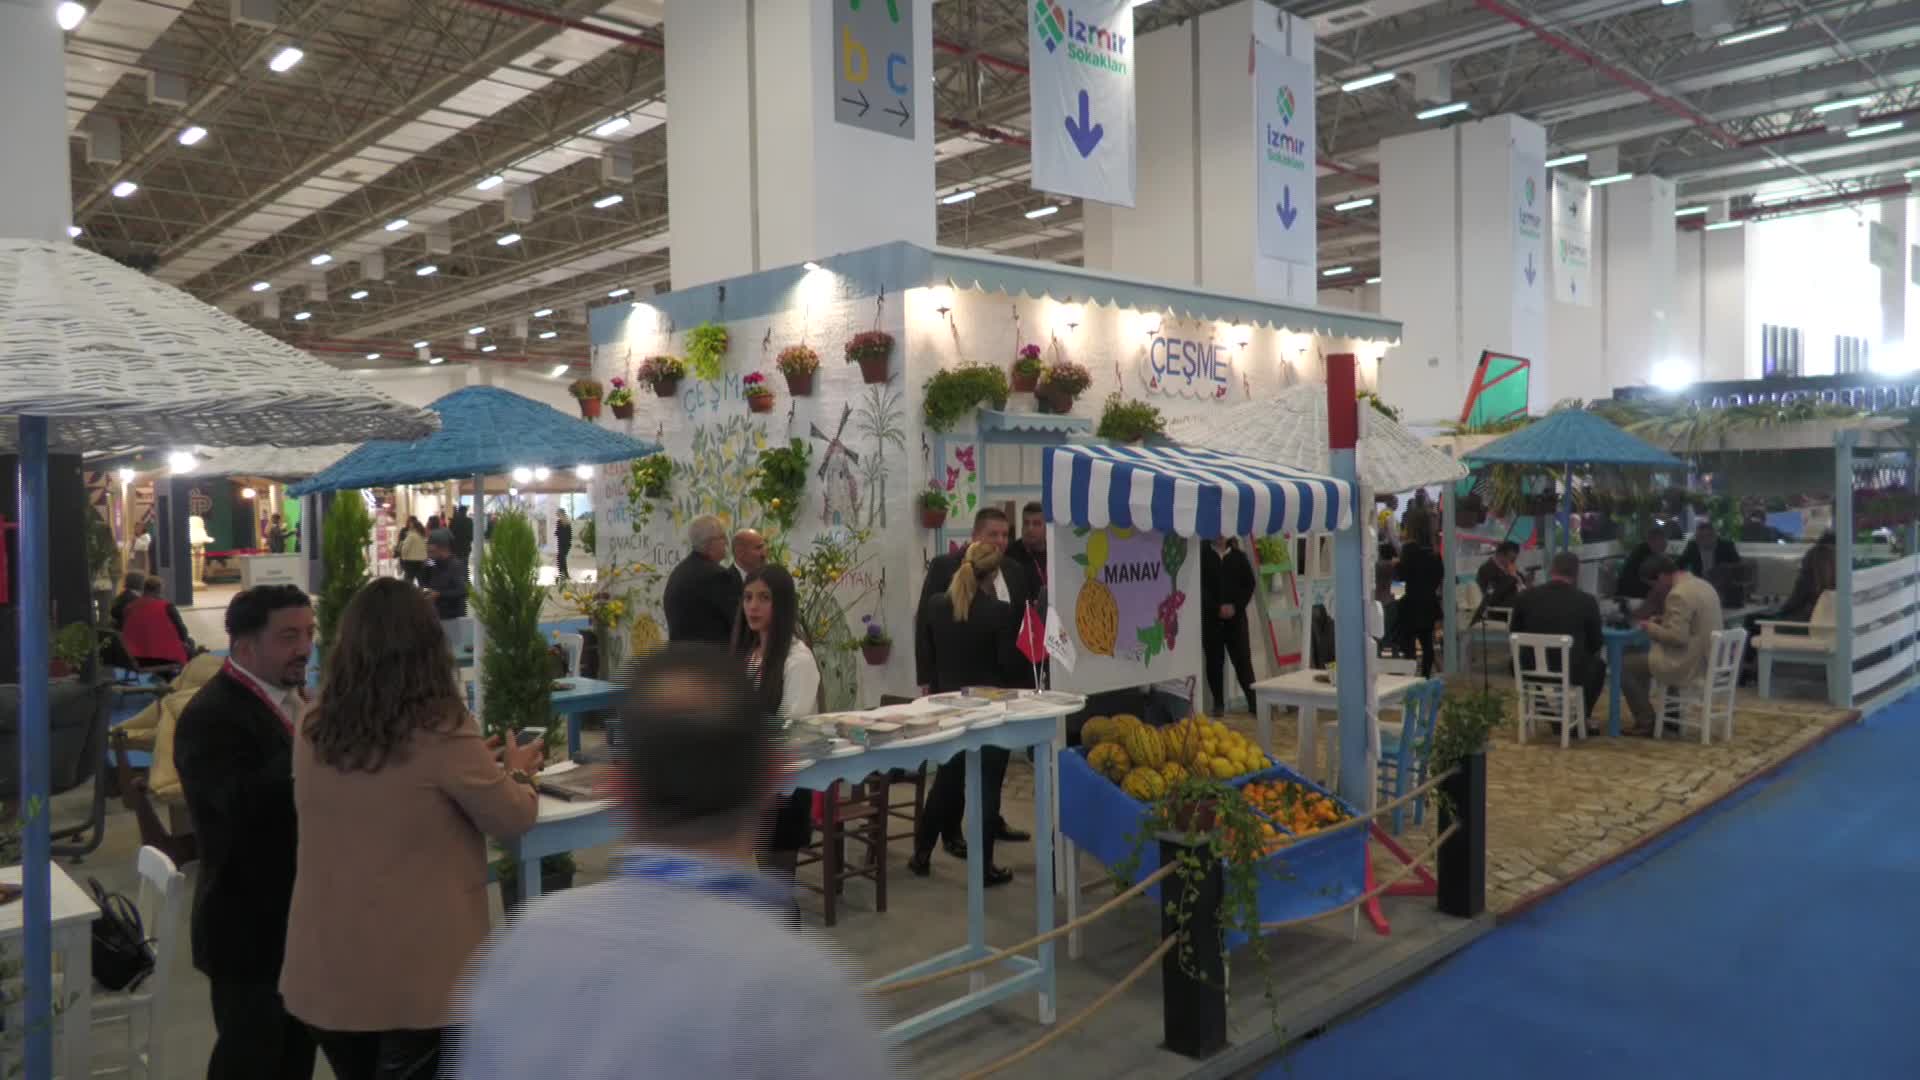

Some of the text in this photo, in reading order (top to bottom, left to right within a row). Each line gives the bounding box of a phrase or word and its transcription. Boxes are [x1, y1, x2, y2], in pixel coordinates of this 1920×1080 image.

[842, 23, 869, 85] b
[888, 52, 908, 95] c
[1151, 337, 1227, 385] ÇEŞME
[684, 373, 744, 418] ÇEŞM
[1105, 561, 1161, 585] MANAV
